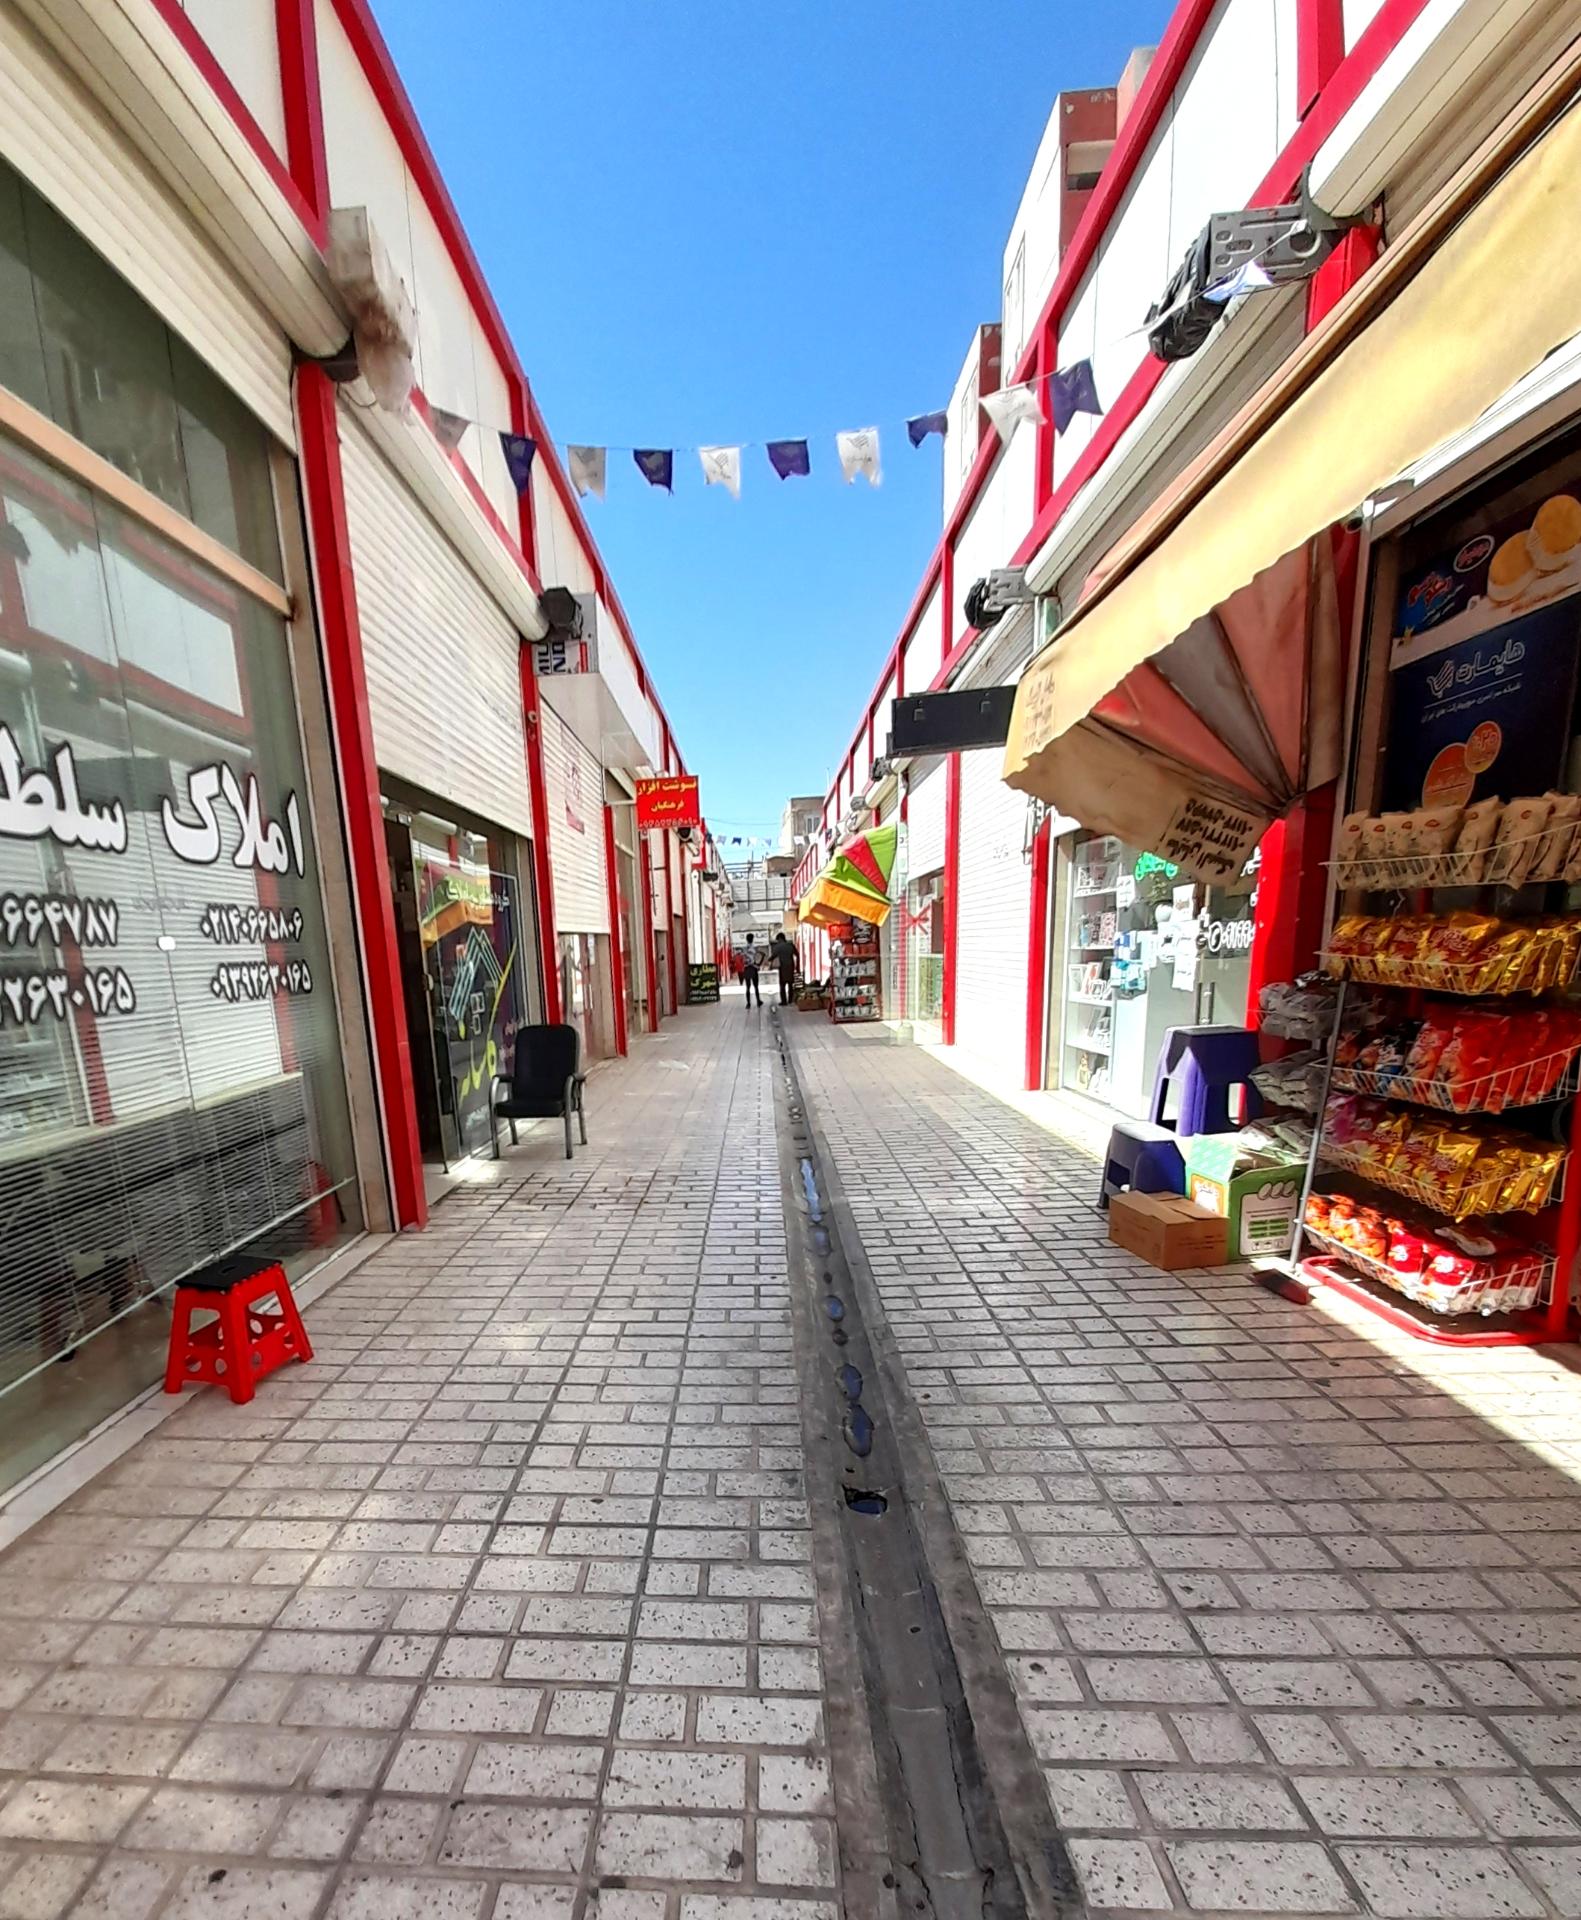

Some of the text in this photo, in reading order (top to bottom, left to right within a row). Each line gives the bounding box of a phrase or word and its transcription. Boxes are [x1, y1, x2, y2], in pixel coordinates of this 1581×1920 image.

[1457, 640, 1526, 685] هایمارت
[638, 778, 697, 796] نوشت افزار
[161, 761, 304, 878] املاک
[0, 959, 313, 1025] ۰۹۳۹۲۶۳۰۱۶۵ ۲۶۳۰۱۶۵
